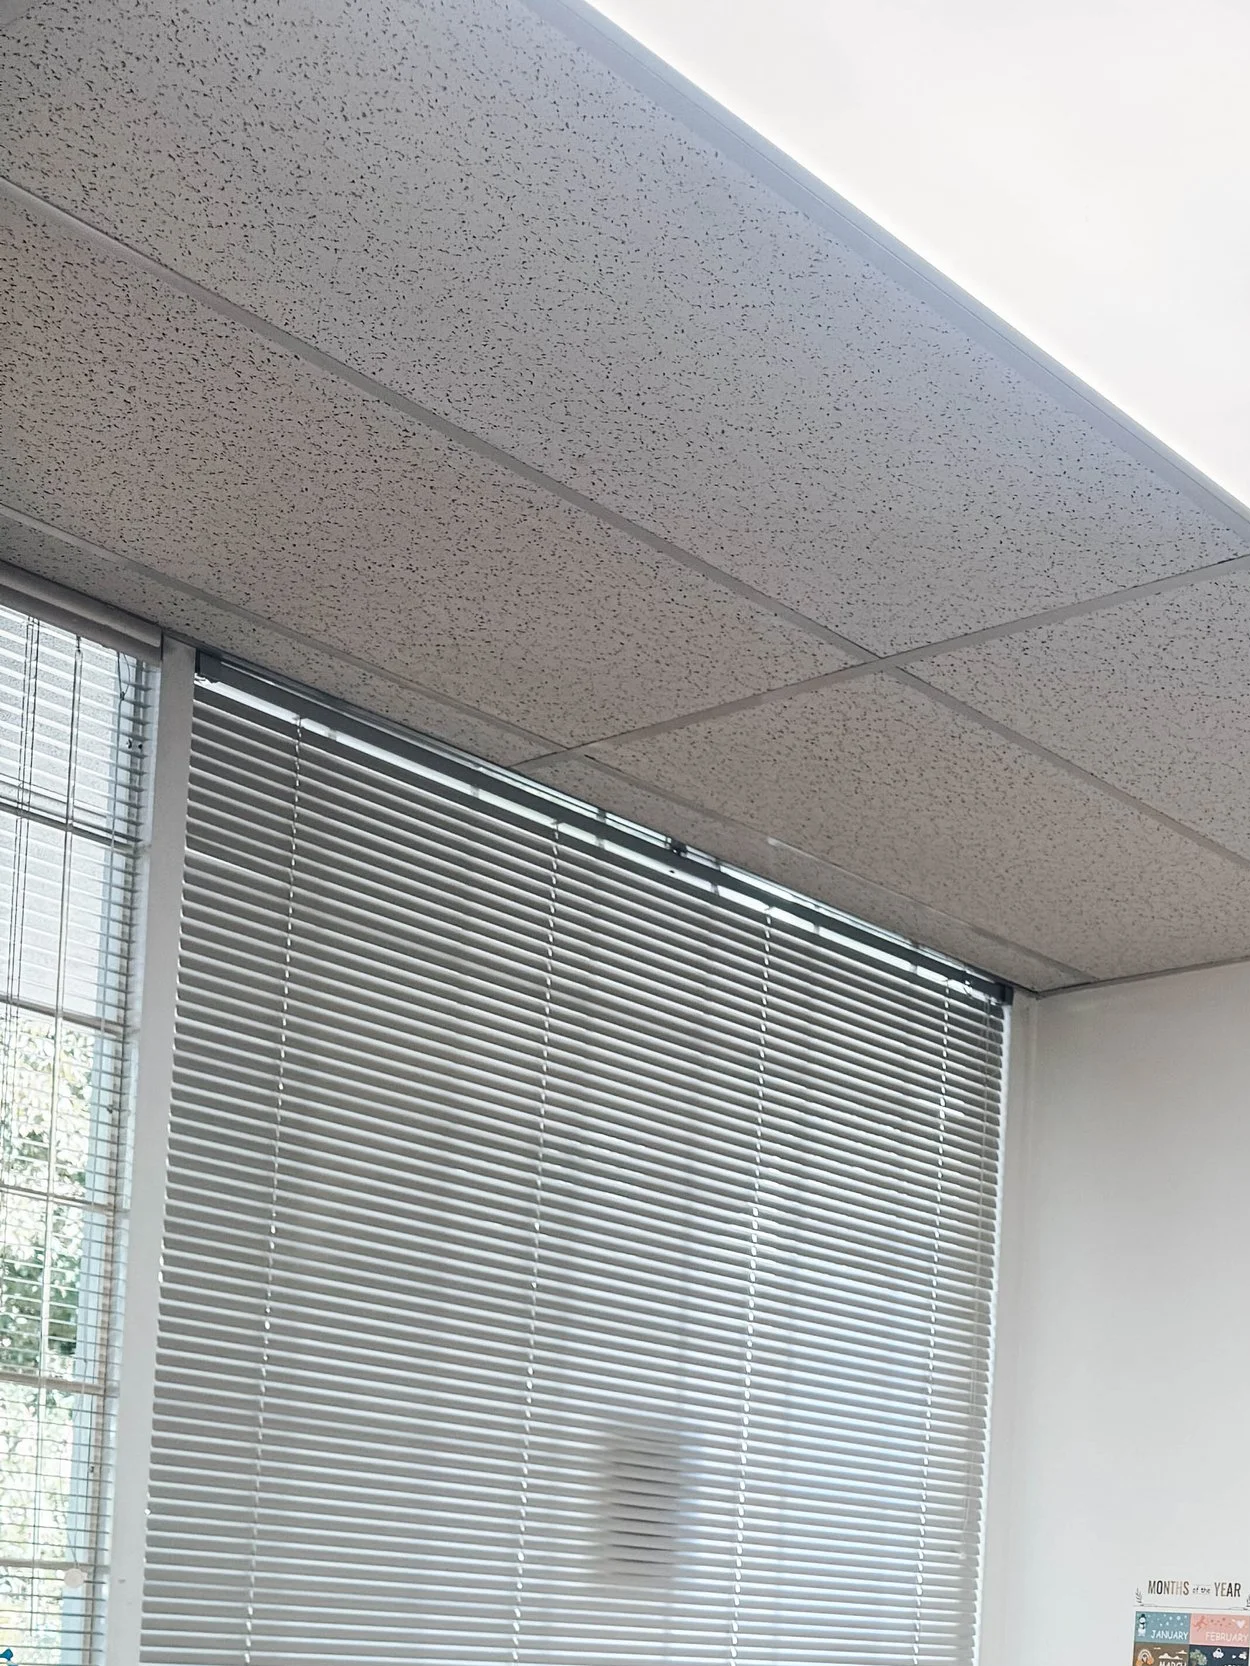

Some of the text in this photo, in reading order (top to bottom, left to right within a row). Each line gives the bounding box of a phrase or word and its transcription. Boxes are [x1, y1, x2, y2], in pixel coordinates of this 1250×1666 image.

[1148, 1580, 1190, 1596] MONTHS
[1214, 1582, 1241, 1597] YEAR
[1151, 1630, 1189, 1640] JANUARY
[1206, 1632, 1248, 1642] FEBRUARY
